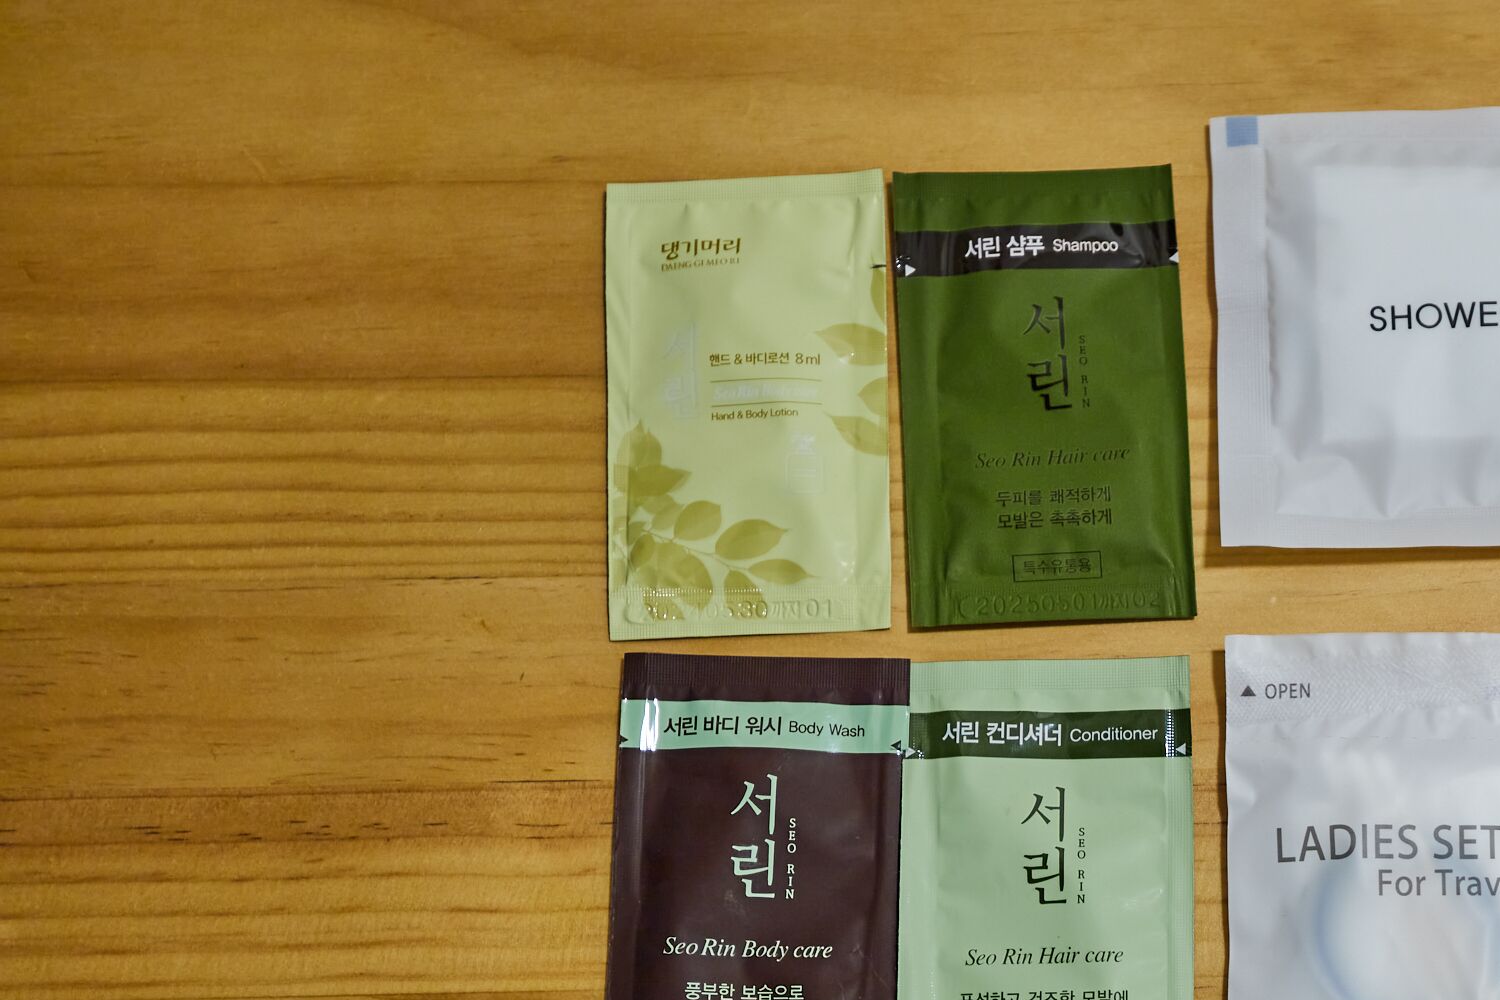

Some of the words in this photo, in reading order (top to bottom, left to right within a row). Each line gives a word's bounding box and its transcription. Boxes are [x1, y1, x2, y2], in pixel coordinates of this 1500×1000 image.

[661, 238, 741, 260] 댕기머리
[965, 236, 1000, 259] 서린
[1006, 235, 1045, 256] 샴푸
[1053, 239, 1119, 253] Shampoo
[745, 352, 790, 366] 바디로션
[711, 411, 735, 421] Hand
[745, 408, 768, 420] Body
[770, 407, 799, 418] Lotion
[975, 452, 1006, 469] Seo
[1012, 451, 1041, 467] Rin
[1048, 449, 1090, 465] Hair
[1093, 449, 1130, 461] care
[996, 490, 1042, 507] 두피를
[1050, 486, 1111, 504] 쾌적하게
[997, 511, 1044, 529] 모발은
[1050, 508, 1112, 527] 촉촉하게
[1265, 683, 1311, 699] OPEN
[663, 716, 698, 737] 서린
[703, 715, 739, 735] 바디
[745, 716, 782, 736] 워시
[789, 721, 824, 736] Body
[829, 723, 865, 737] Wash
[942, 721, 979, 744] 서린
[1070, 727, 1158, 742] Conditioner
[730, 774, 778, 898] 서린
[787, 817, 797, 854] SEO
[1021, 786, 1067, 905] 서린
[1077, 827, 1086, 859] SEO
[1276, 823, 1418, 863] LADIES
[785, 863, 796, 900] RIN
[1077, 869, 1086, 904] RIN
[1378, 869, 1426, 896] For
[663, 936, 699, 955] Seo
[701, 938, 735, 957] Rin
[742, 939, 789, 962] Body
[793, 945, 833, 959] care
[965, 949, 997, 966] Seo
[1002, 948, 1033, 965] Rin
[1038, 946, 1080, 965] Hair
[1085, 949, 1124, 963] care
[684, 982, 735, 1000] 풍부한
